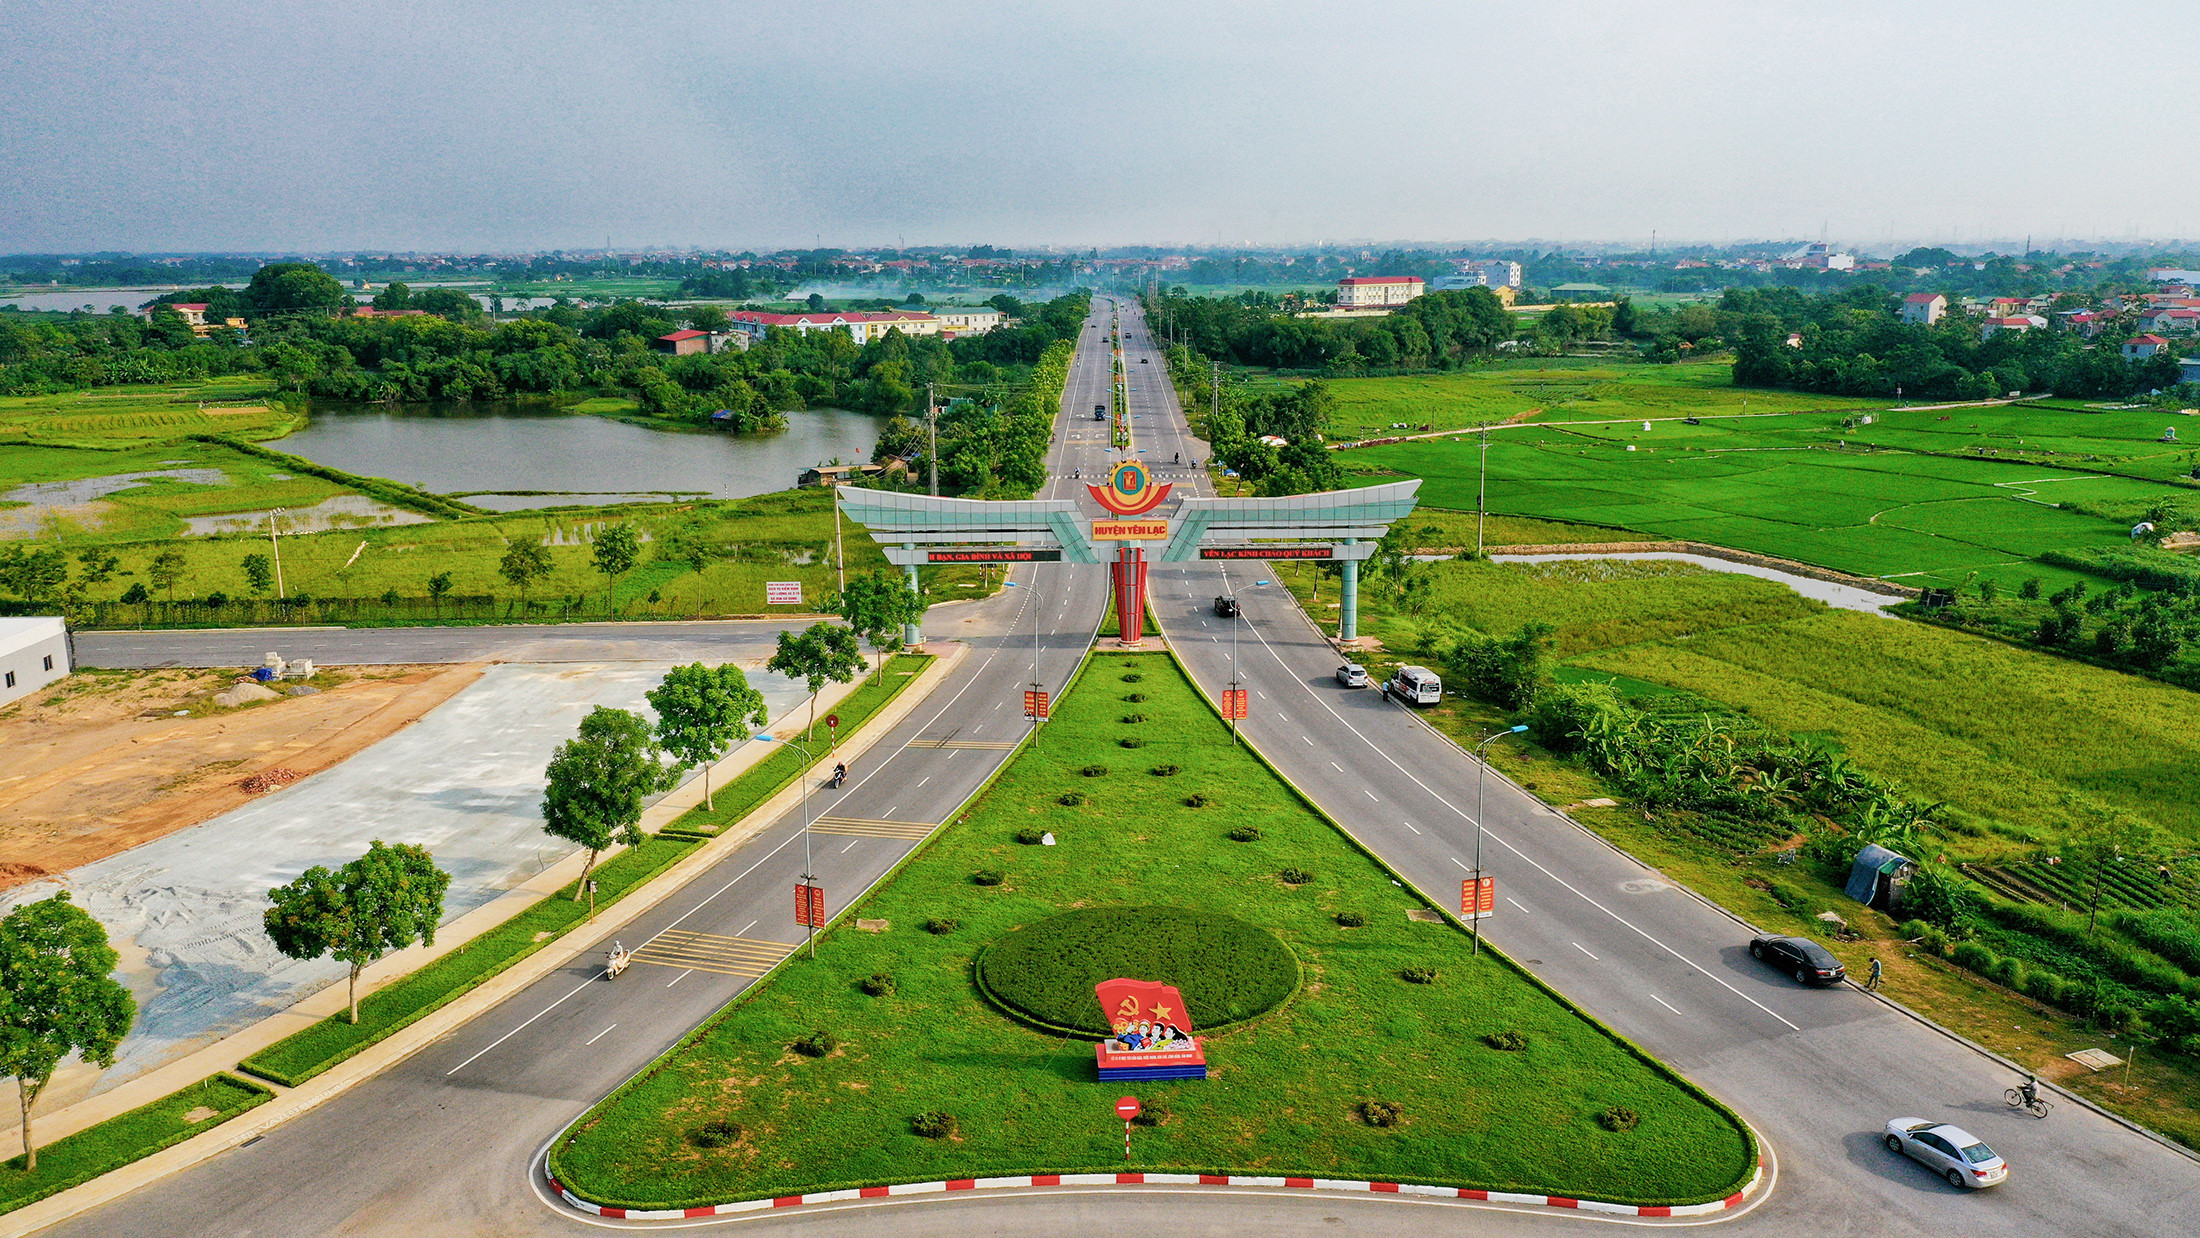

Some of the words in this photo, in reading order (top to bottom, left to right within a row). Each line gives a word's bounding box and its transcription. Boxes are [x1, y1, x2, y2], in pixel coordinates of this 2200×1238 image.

[1094, 524, 1126, 536] HUYỆN
[1128, 524, 1146, 534] YÊN
[1147, 526, 1166, 536] LẠC
[1017, 552, 1032, 561] HỘI
[1221, 550, 1236, 559] LẠC
[1238, 549, 1258, 558] KÍNH
[1259, 549, 1282, 557] CHÀO
[1283, 549, 1300, 558] QUÝ
[1301, 549, 1330, 557] KHÁCH
